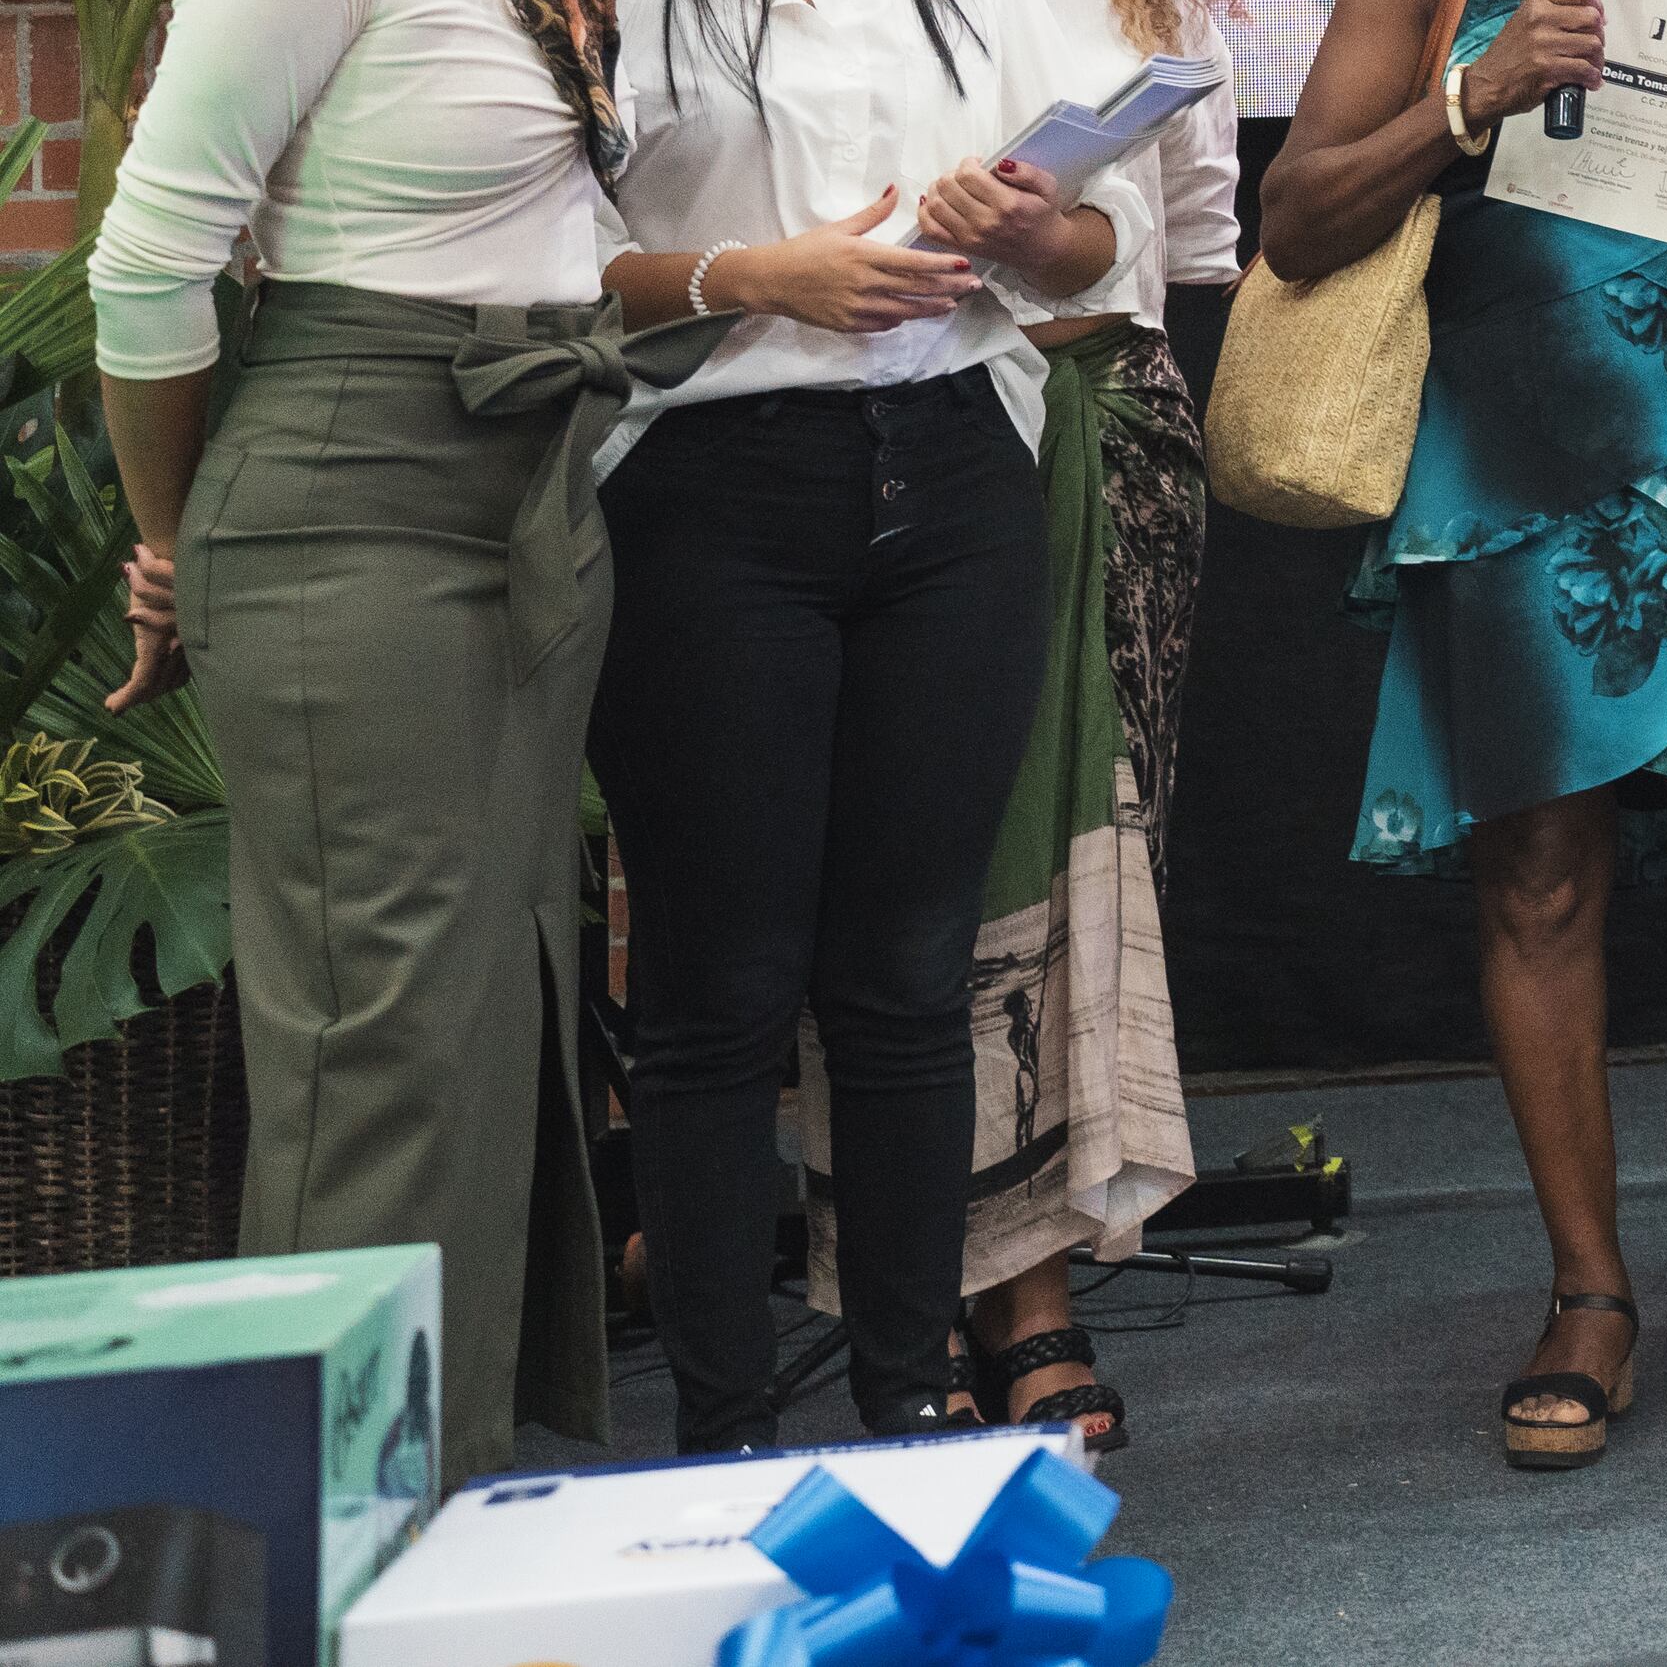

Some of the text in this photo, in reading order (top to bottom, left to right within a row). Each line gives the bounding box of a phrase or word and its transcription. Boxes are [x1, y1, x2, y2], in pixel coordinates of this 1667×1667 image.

[1601, 66, 1634, 83] Deira
[1623, 135, 1649, 148] trenza
[1649, 143, 1655, 151] y
